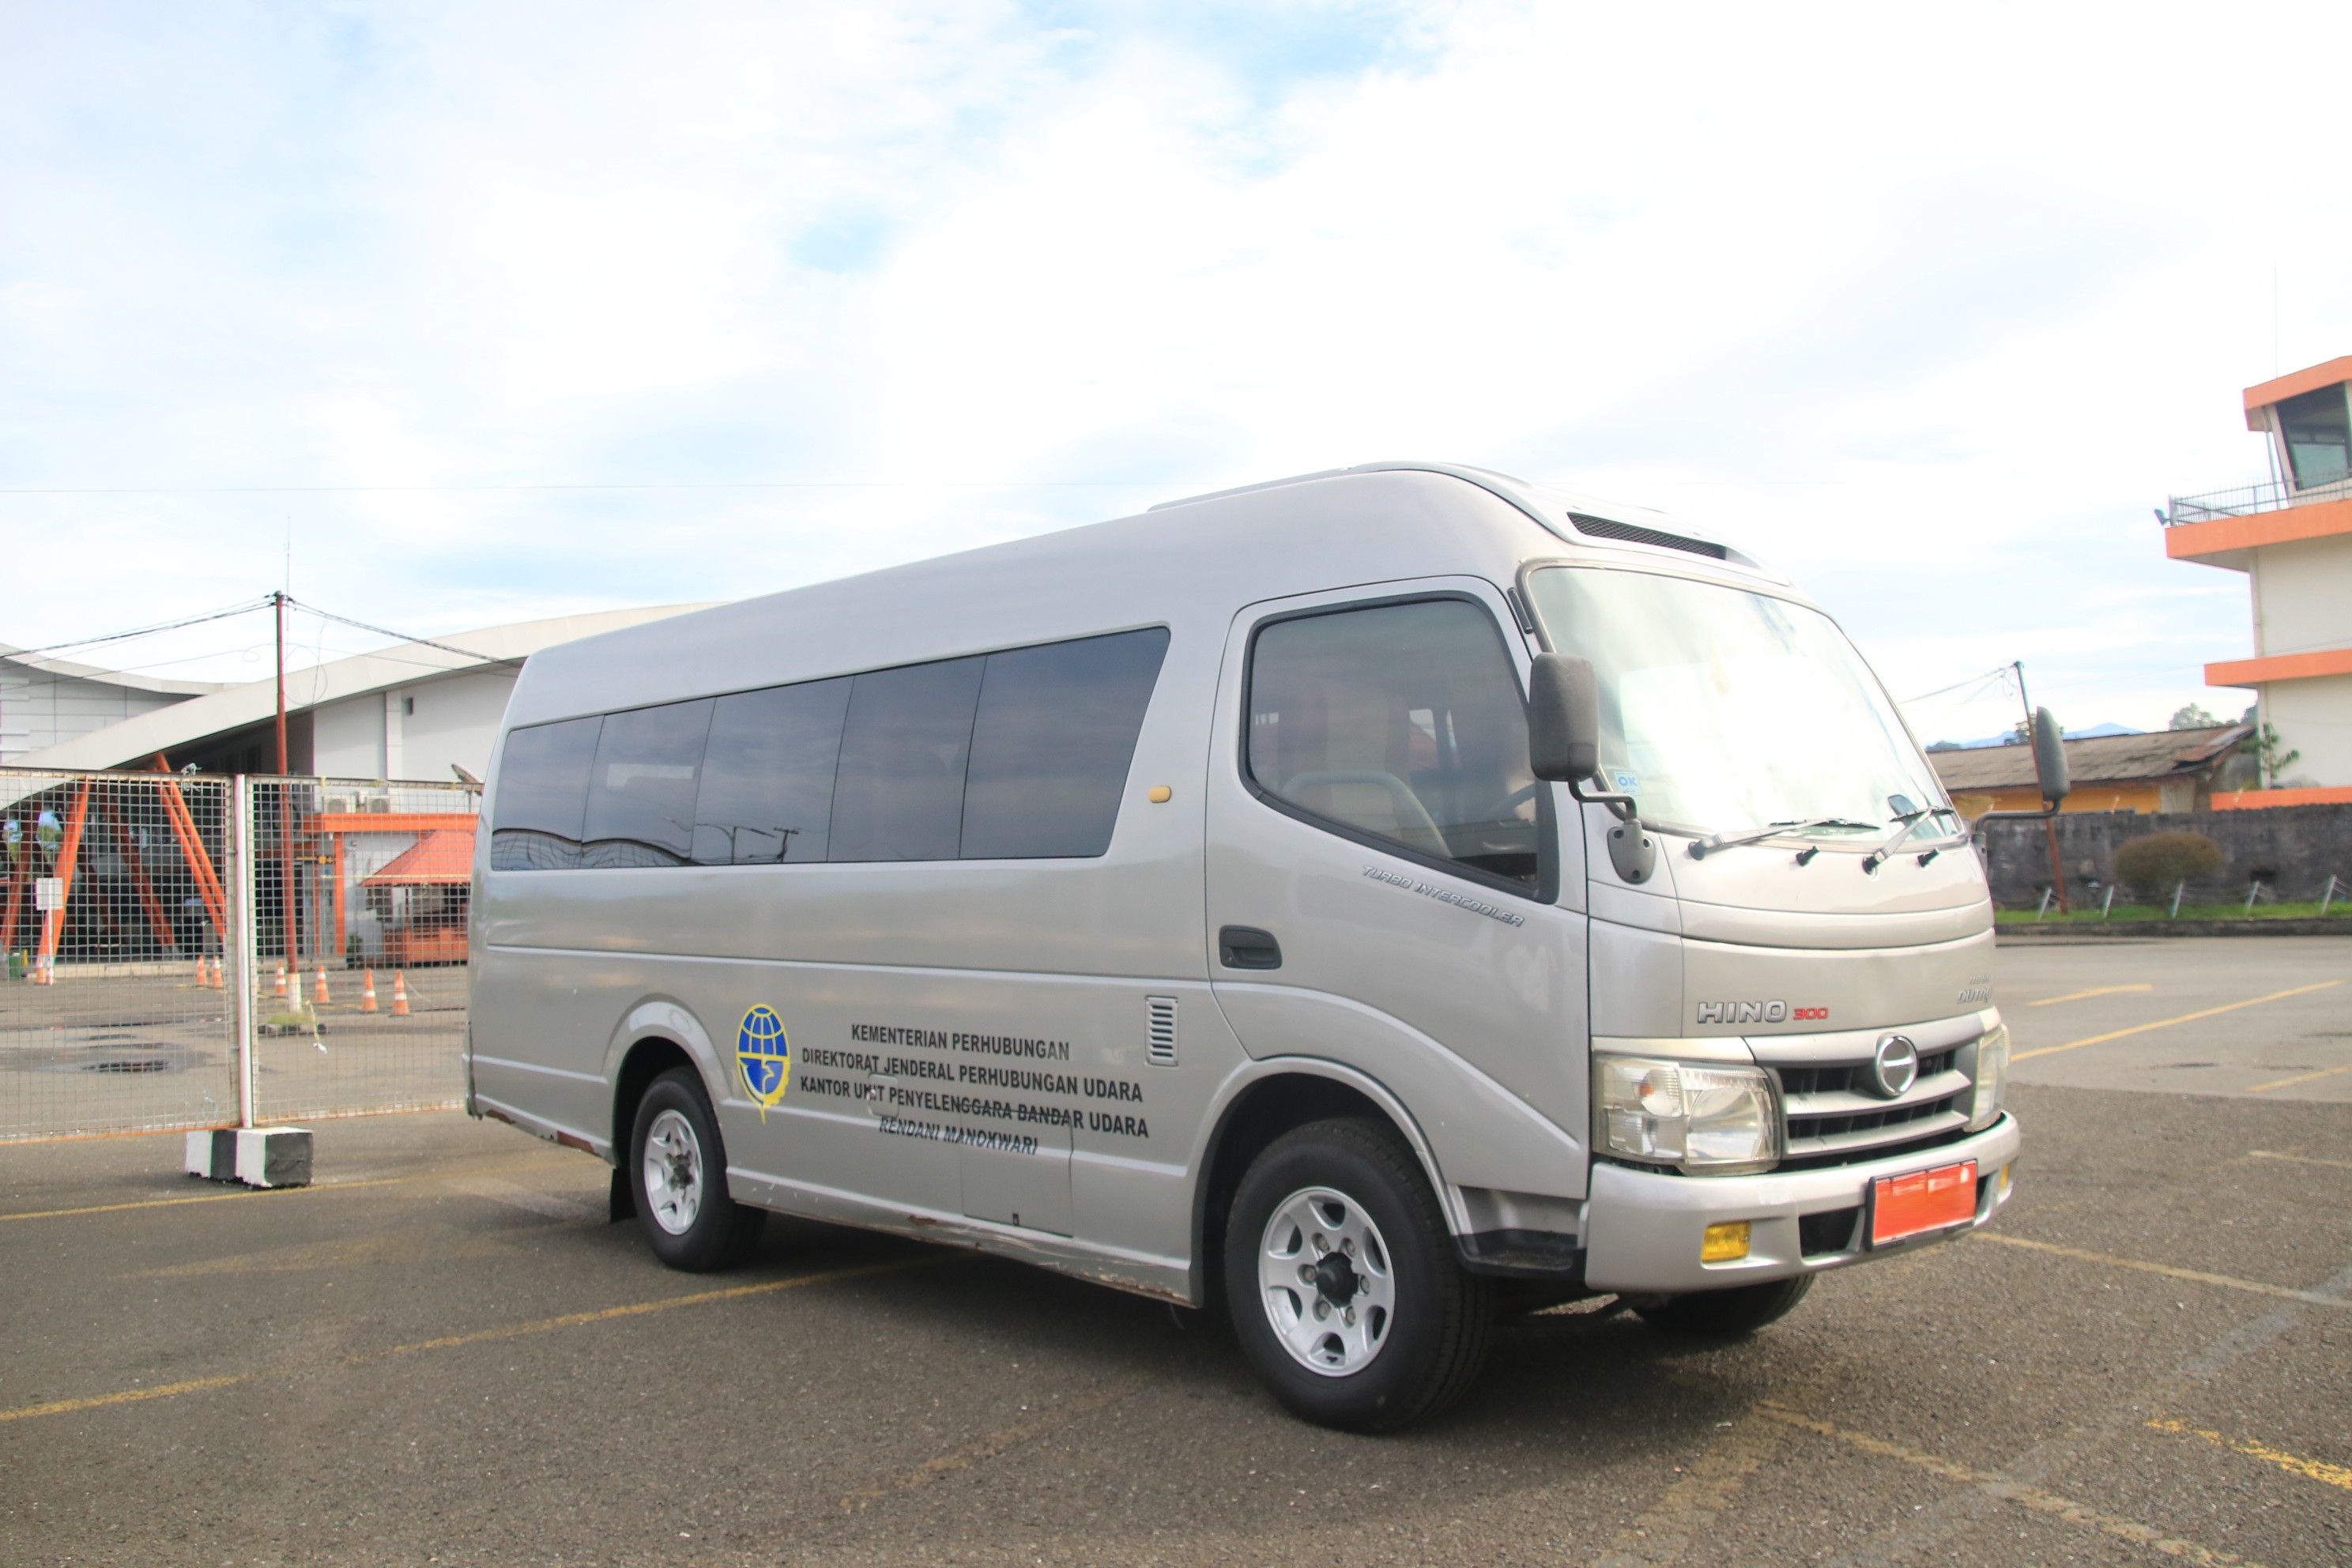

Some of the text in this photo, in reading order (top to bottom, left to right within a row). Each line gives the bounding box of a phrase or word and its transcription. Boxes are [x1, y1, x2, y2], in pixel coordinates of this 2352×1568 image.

[1618, 776, 1638, 787] OK
[1363, 866, 1525, 927] TURBO INTERCOOLER
[1697, 999, 1829, 1023] HINO 300
[851, 1024, 1069, 1061] KEMENTERIAN PERHUBUNGAN
[802, 1047, 1144, 1102] DIREKTORAT JENDERAL PERHUBUNGAN UDARA
[801, 1076, 850, 1097] KANTOR
[889, 1086, 1012, 1120] PENYELENGGARA
[1017, 1104, 1084, 1129] BANDAR
[1089, 1112, 1149, 1138] UDARA
[879, 1116, 1038, 1155] RENDANI MANOKWARI
